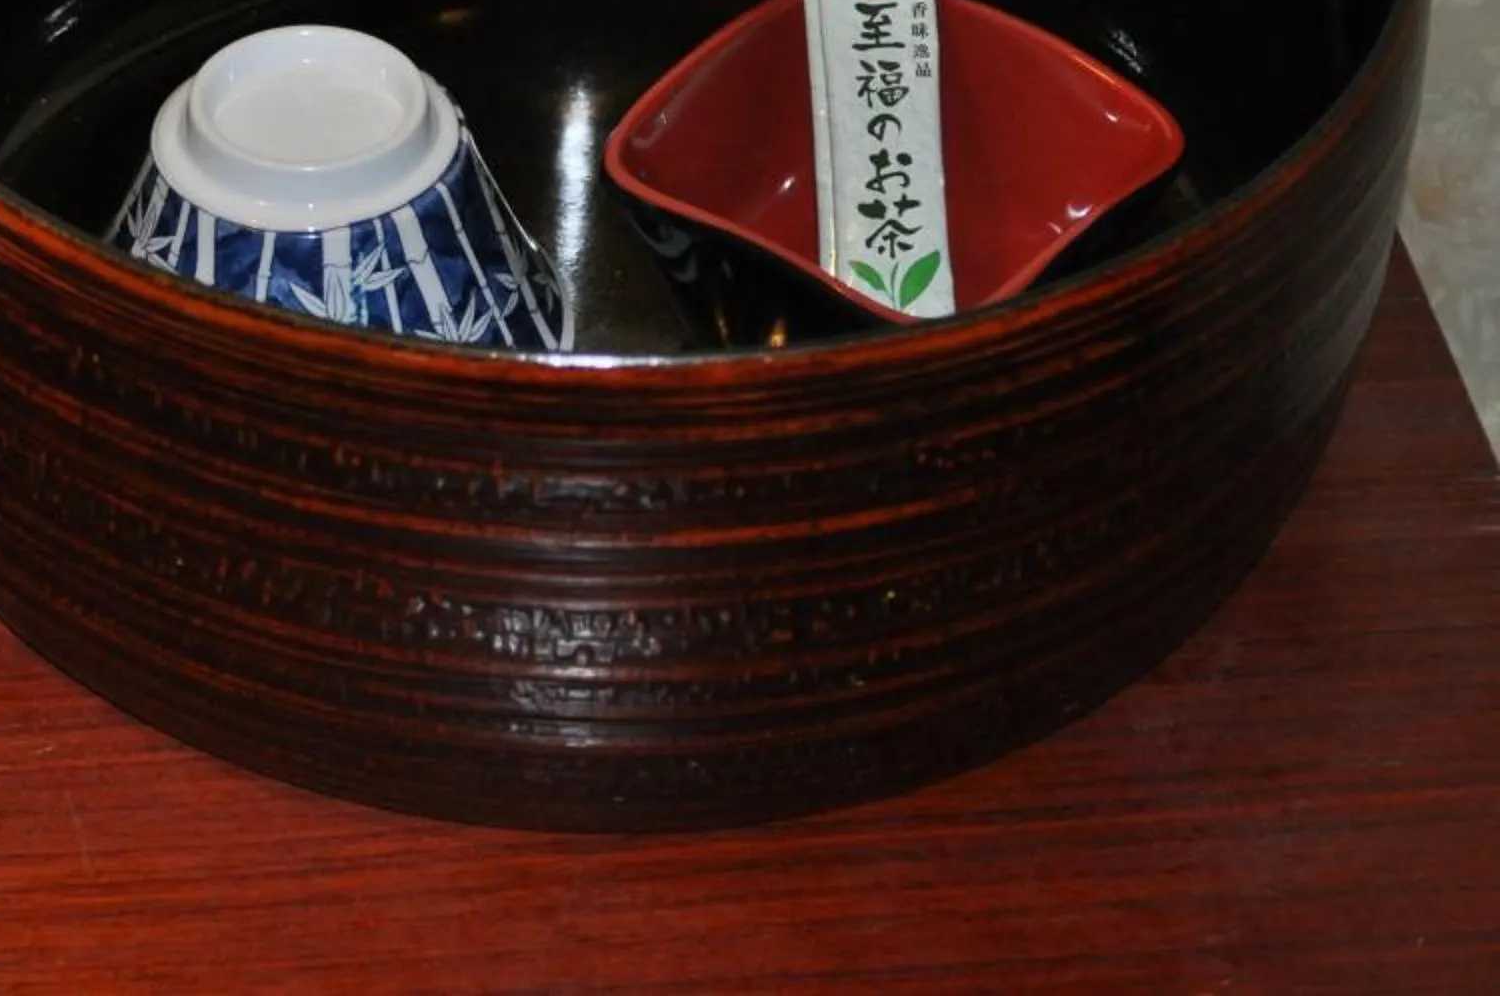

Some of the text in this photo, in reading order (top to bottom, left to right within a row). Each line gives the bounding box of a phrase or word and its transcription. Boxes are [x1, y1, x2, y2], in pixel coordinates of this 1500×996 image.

[852, 2, 923, 259] 至福のお茶
